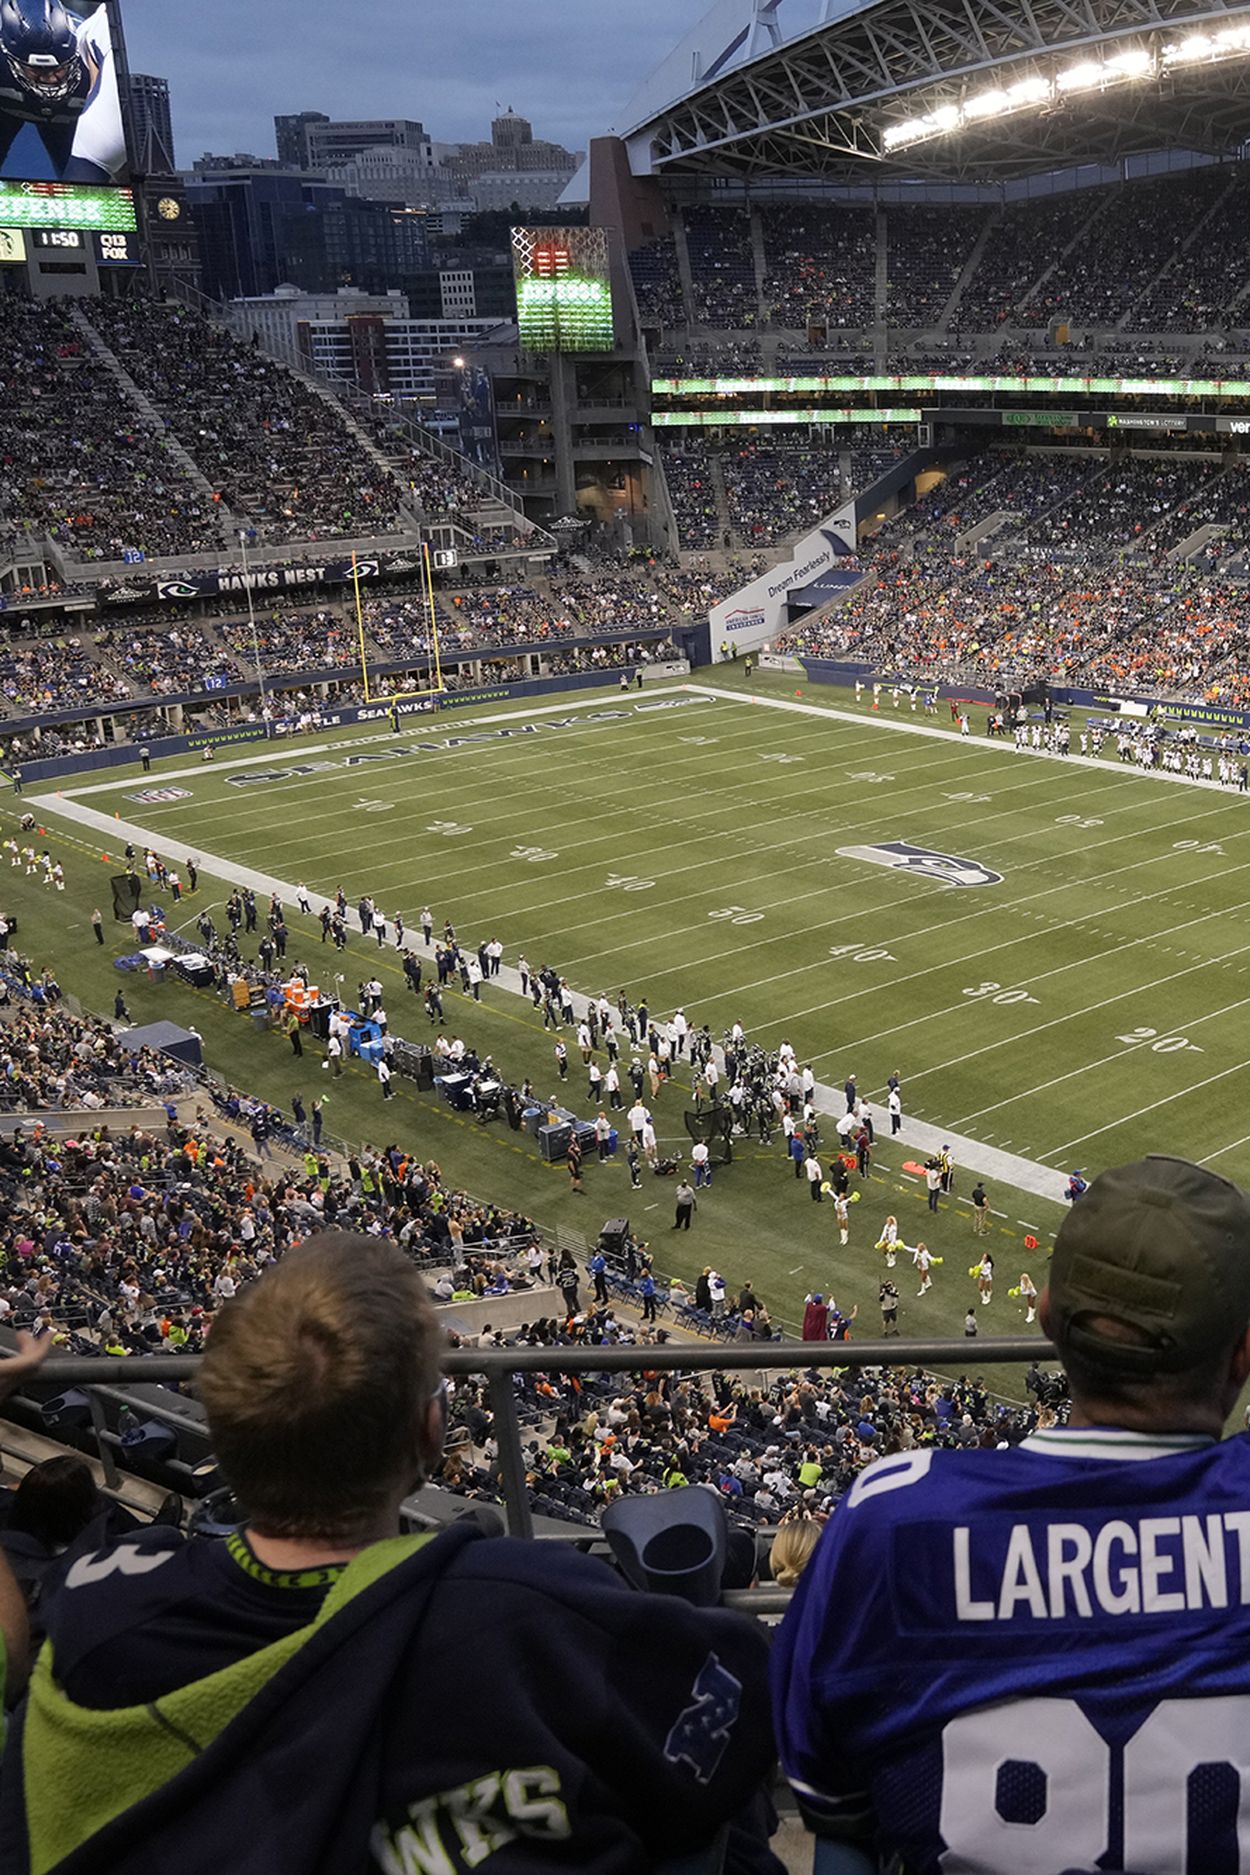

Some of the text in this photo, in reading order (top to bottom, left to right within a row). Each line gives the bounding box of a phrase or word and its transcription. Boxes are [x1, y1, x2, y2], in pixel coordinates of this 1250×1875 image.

[100, 234, 127, 247] Q13
[101, 246, 128, 260] FOX
[126, 551, 142, 564] 12
[217, 567, 326, 591] HAWKS NEST
[767, 550, 831, 598] Dream Fearlessly
[812, 582, 851, 591] LUMEN
[210, 678, 222, 689] 12
[275, 715, 341, 734] SALE
[224, 709, 633, 788] SEAHAWKS
[708, 905, 765, 925] 50
[828, 943, 889, 963] 40
[962, 981, 1029, 1004] 30
[1115, 1026, 1190, 1053] 20
[65, 1543, 176, 1590] 3
